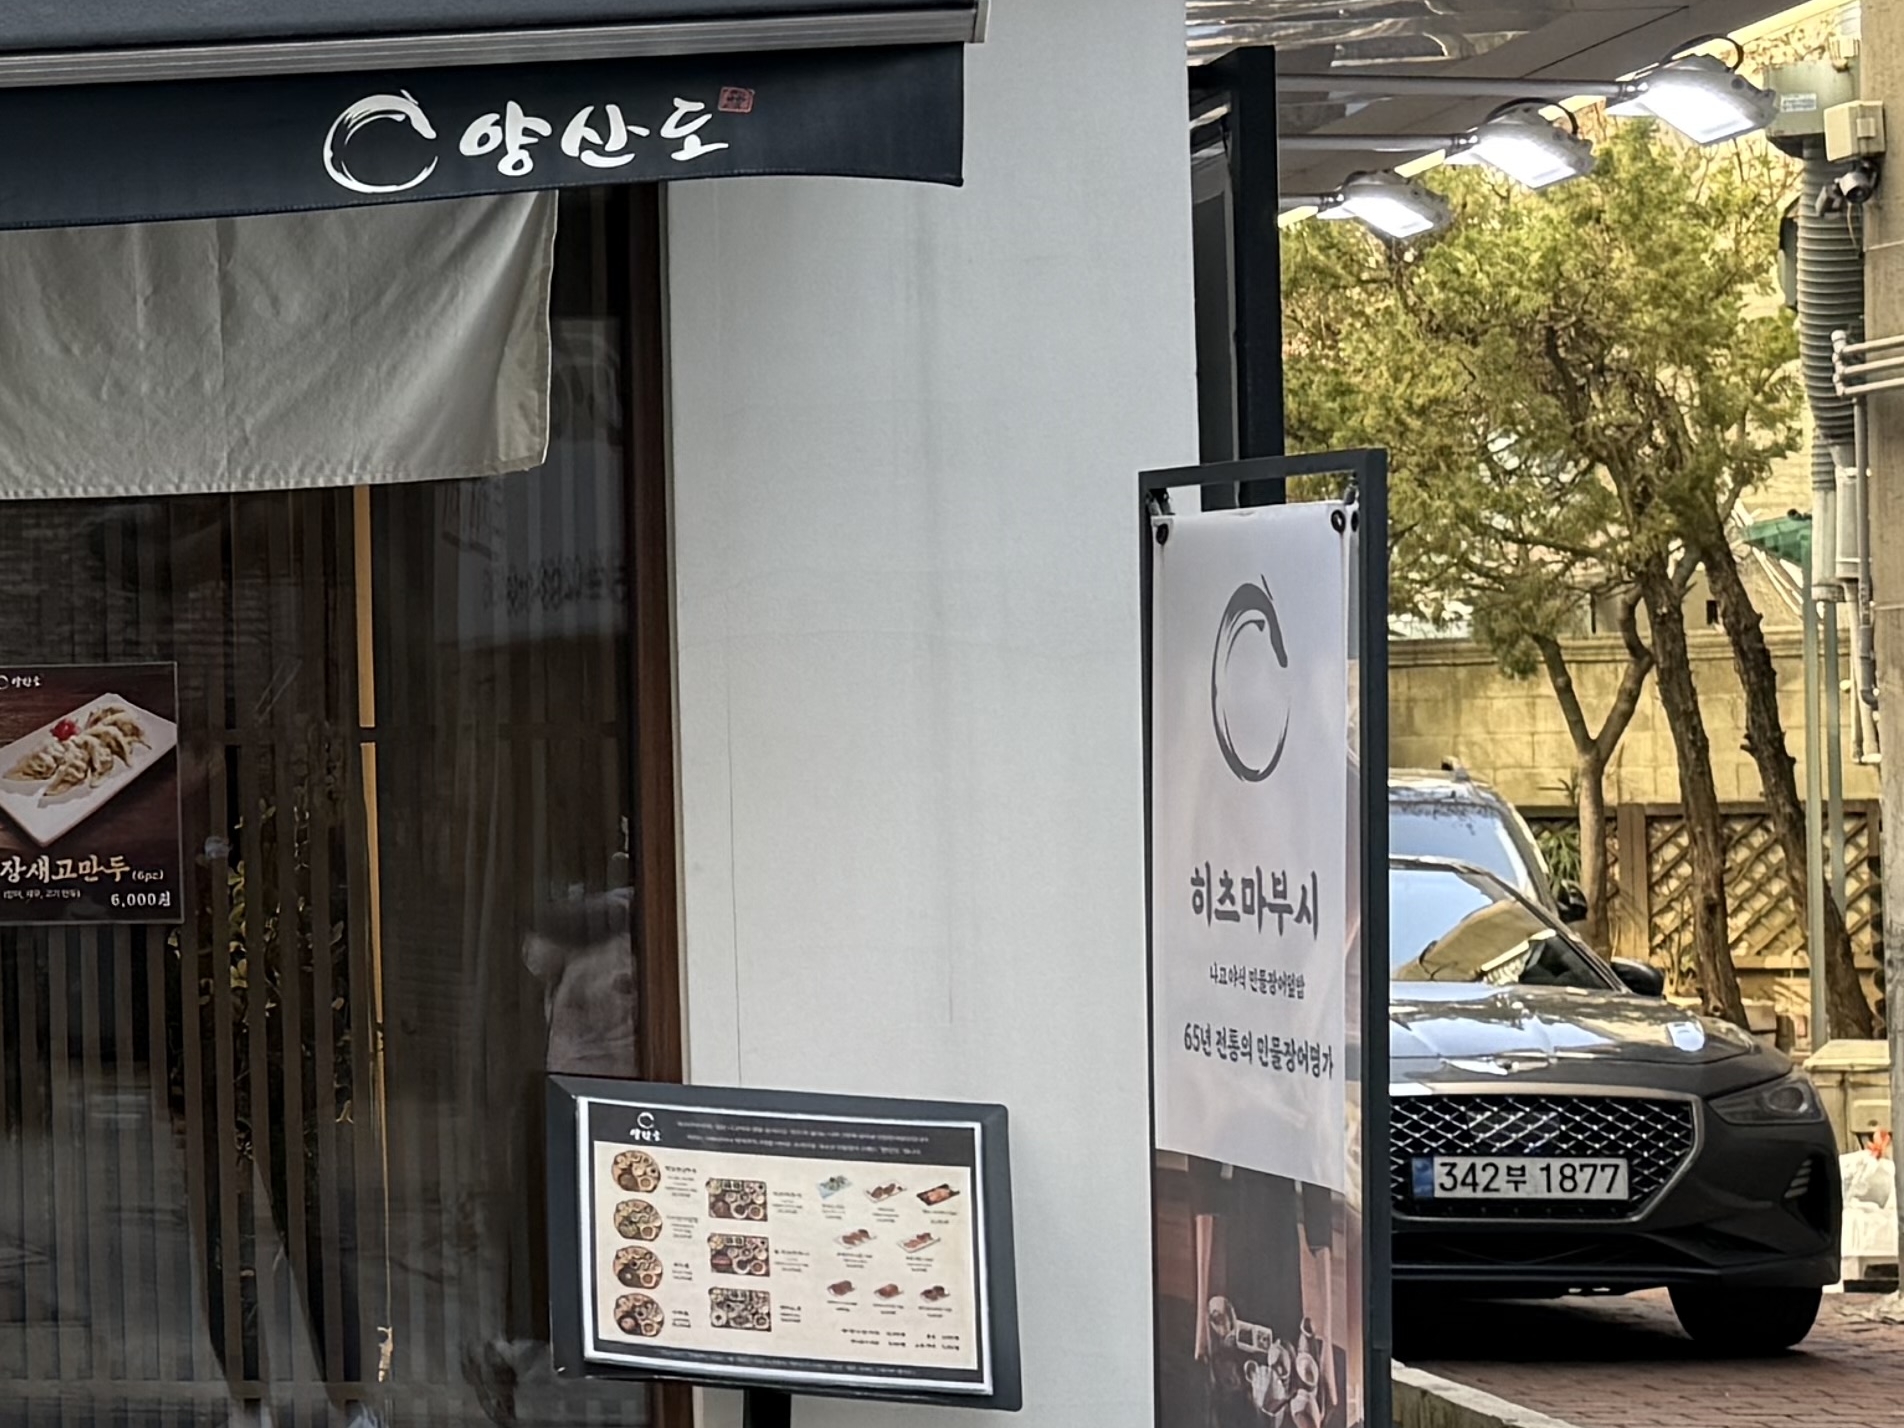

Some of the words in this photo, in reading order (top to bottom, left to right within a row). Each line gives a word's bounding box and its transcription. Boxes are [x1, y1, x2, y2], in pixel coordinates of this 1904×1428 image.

[459, 97, 730, 177] 양산도
[0, 855, 131, 884] 장새고만두
[1190, 861, 1319, 940] 히츠마부시
[1184, 1023, 1211, 1057] 65년
[1215, 1027, 1253, 1064] 전통의
[1257, 1034, 1333, 1080] 민물장어명가
[1539, 1162, 1622, 1194] 1877
